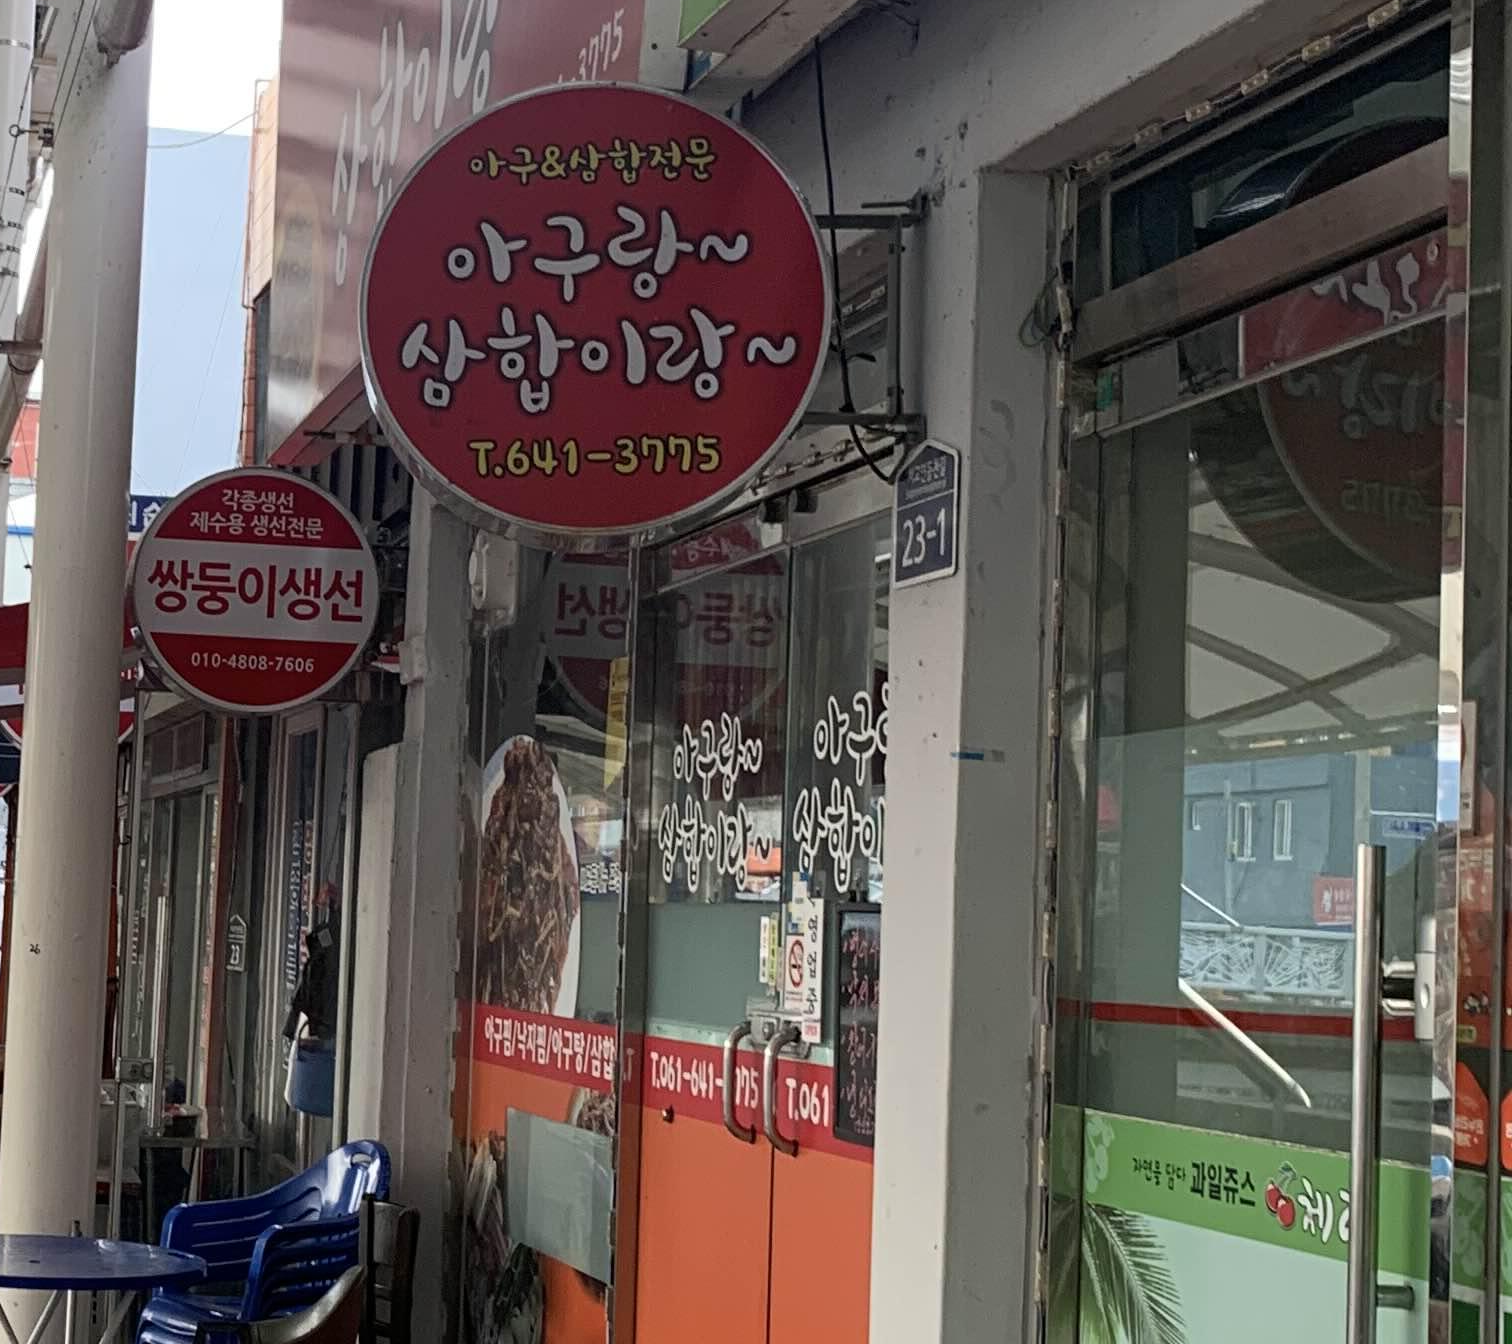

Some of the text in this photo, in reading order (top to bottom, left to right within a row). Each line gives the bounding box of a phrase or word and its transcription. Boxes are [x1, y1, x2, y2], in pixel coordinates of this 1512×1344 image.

[470, 138, 716, 185] 아구&삼합전문
[447, 205, 749, 303] 아구랑~
[469, 436, 721, 477] T.641-3775
[221, 488, 295, 514] 각종생선
[190, 511, 246, 536] 제수용
[250, 516, 324, 540] 생선전문
[902, 507, 946, 568] 23-1
[147, 558, 364, 623] 쌍둥이생선
[191, 651, 315, 673] 010-4808-7606
[650, 1051, 760, 1109] T.061-641-775
[1165, 1162, 1186, 1191] 담다
[1190, 1161, 1257, 1207] 과일쥬스
